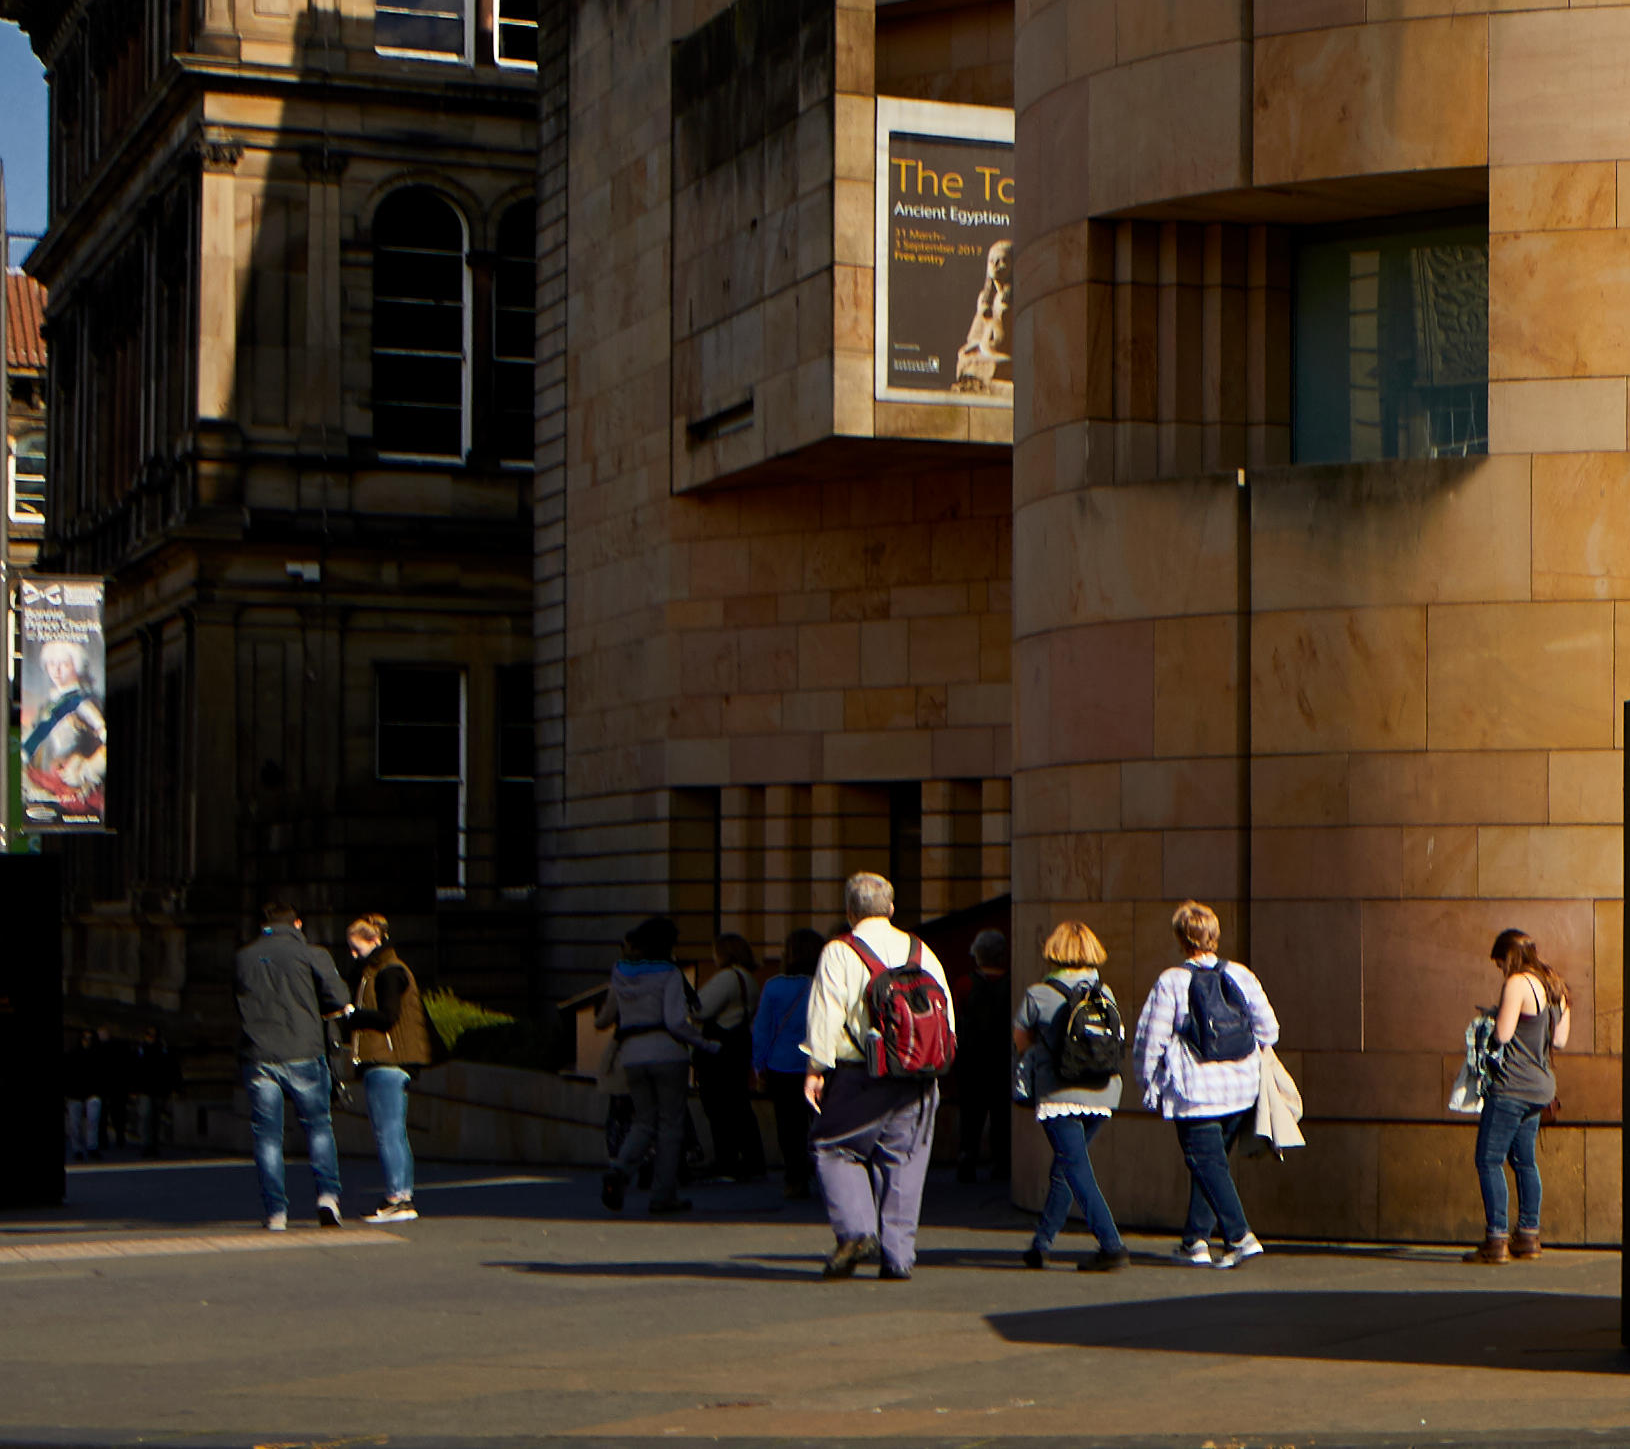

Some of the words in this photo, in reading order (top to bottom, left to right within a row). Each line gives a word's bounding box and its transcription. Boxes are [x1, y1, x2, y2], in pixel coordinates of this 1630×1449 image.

[890, 157, 964, 199] The
[894, 200, 947, 221] Ancient
[950, 205, 1010, 227] Egyptian
[894, 251, 916, 262] Free
[918, 253, 946, 267] entry
